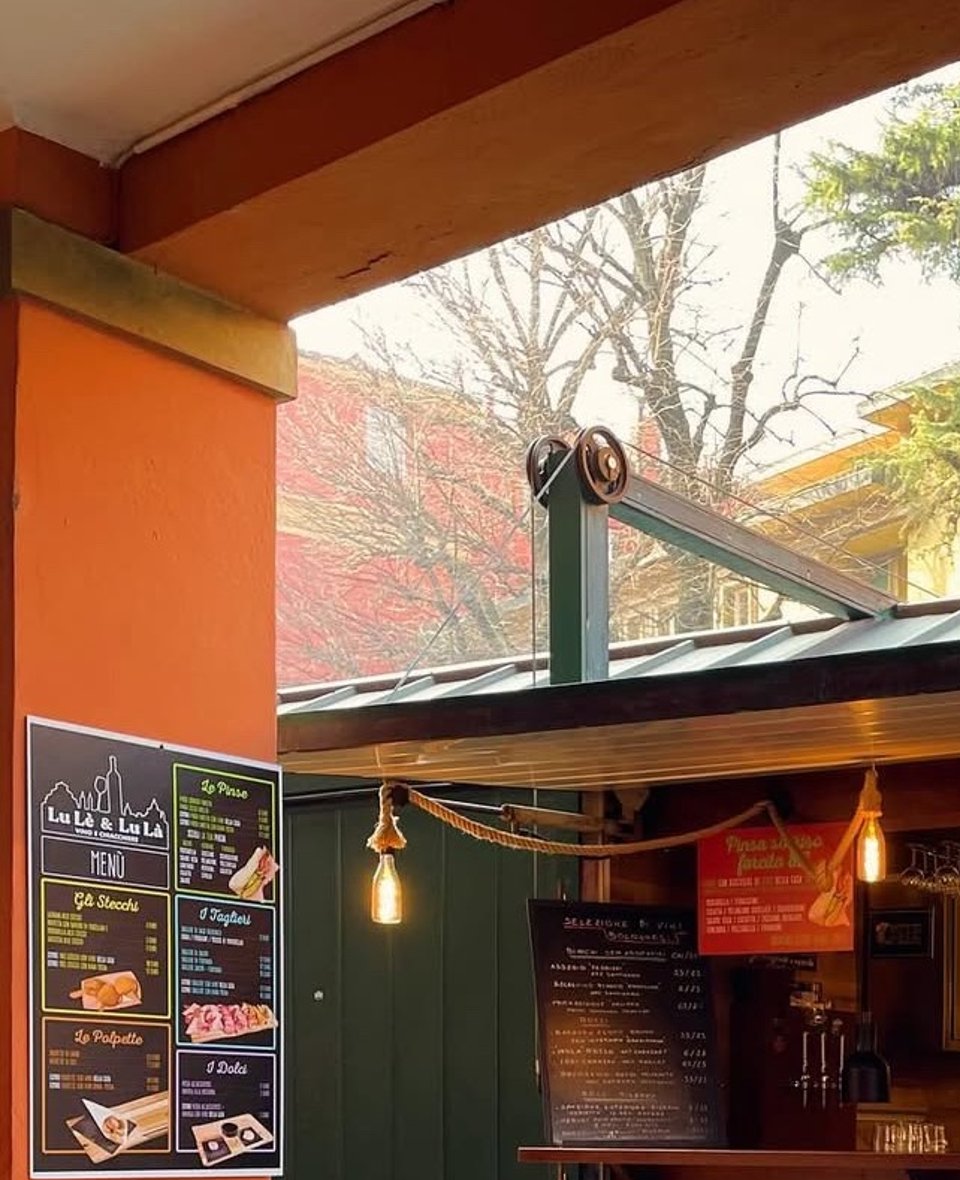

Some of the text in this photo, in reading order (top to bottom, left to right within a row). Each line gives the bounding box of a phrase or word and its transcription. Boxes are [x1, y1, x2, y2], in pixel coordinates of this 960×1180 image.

[48, 806, 164, 838] Lu Lè & Lu Là
[90, 849, 125, 879] MENÙ
[74, 891, 140, 913] Gli Stecchi
[74, 1029, 144, 1049] Le Polpette
[216, 1060, 248, 1075] Dolci
